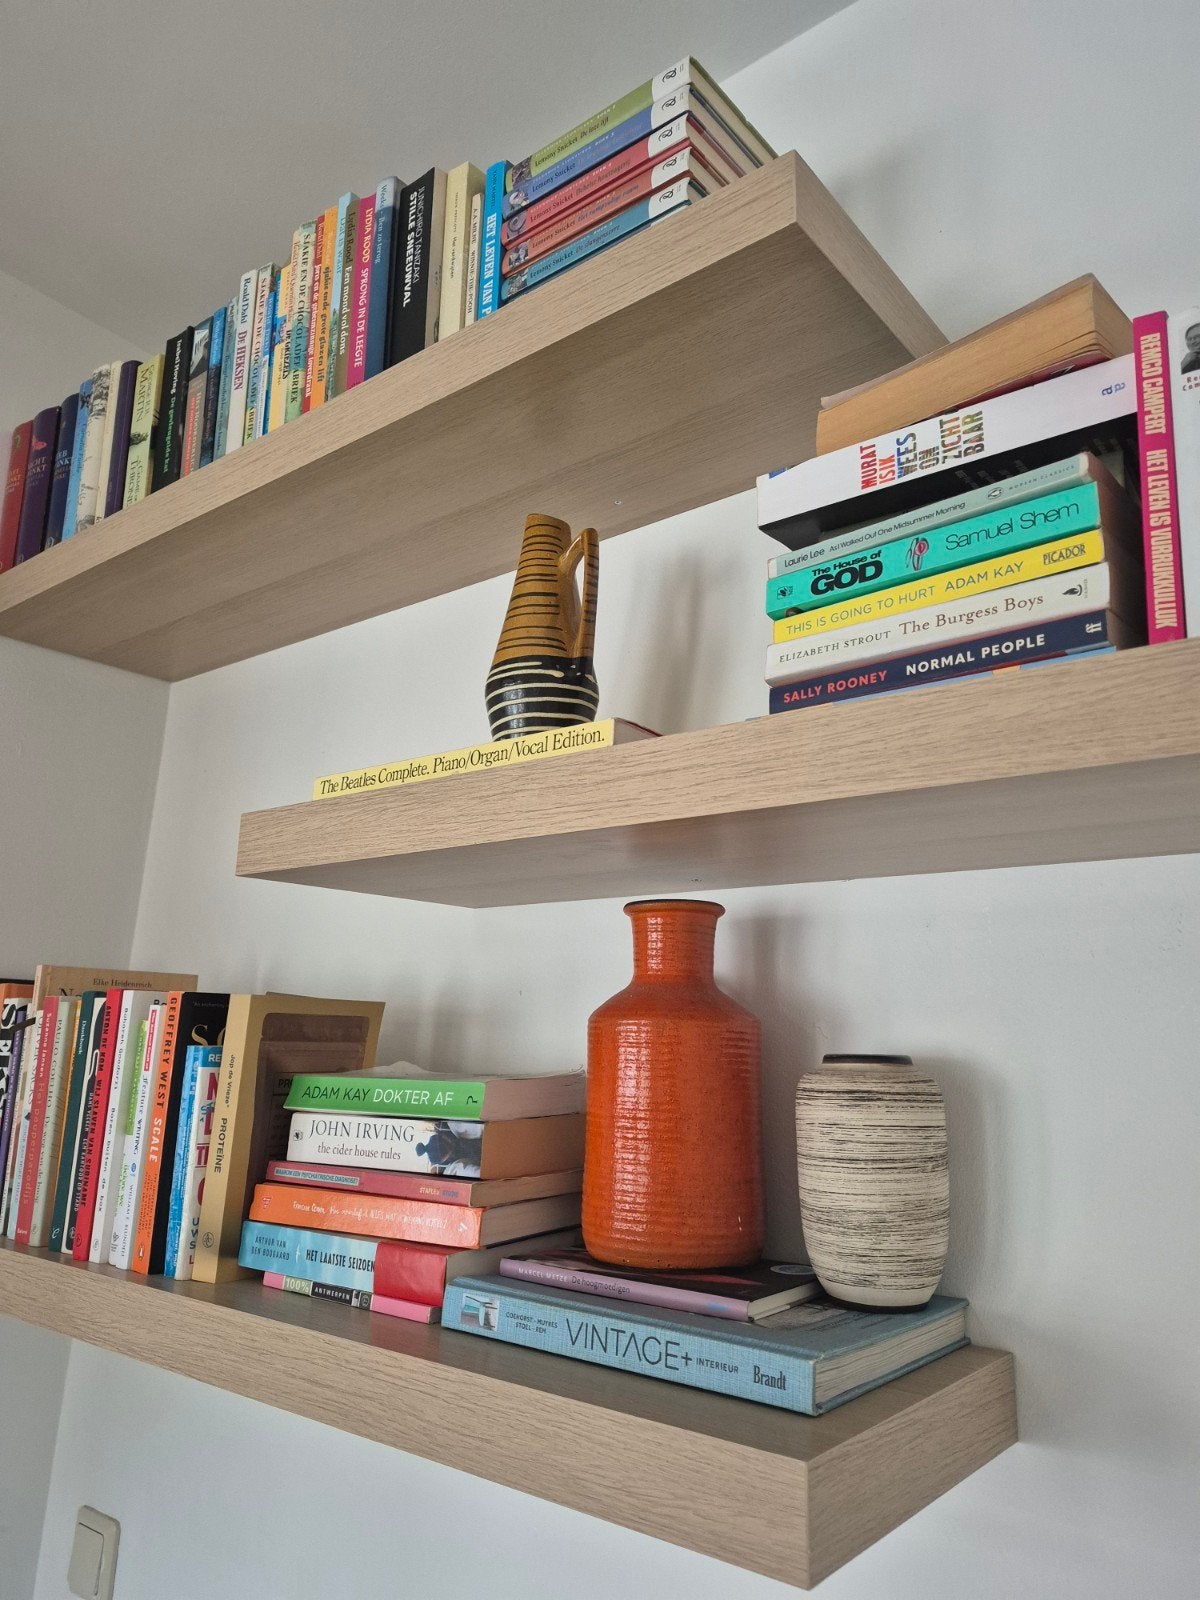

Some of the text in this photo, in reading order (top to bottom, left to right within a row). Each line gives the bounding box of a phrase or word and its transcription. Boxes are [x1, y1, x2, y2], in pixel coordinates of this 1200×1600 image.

[534, 152, 556, 168] Lemony
[557, 135, 577, 152] Snicket
[532, 163, 576, 192] Lemony Snicket
[486, 212, 496, 238] HET
[530, 194, 573, 223] Lemony Snicket
[376, 232, 382, 242] zo
[412, 185, 425, 284] JUNICHIRO TANIZAKI
[554, 221, 575, 235] Snicket
[374, 242, 382, 263] terug
[402, 191, 417, 308] STILLE SNEEUWVAL
[483, 238, 495, 280] LEVEN
[530, 250, 573, 280] Lemony Snicket
[311, 281, 319, 302] en de
[338, 211, 356, 355] Lydia Rood Een mond vol dons
[354, 207, 373, 368] LYDIA ROOD SPRONG IN DE LEEGTE
[482, 279, 493, 305] VAN
[233, 277, 251, 390] Roald Dahl HEKSEN
[290, 232, 311, 404] SJAKIE EN DE CHOCOLADEFABRIEK
[245, 277, 266, 440] SJAKIE EN DE CHOCOLADEFABRIEK
[282, 341, 290, 379] GRIEZELS
[316, 312, 327, 382] grote glazen lift
[135, 368, 148, 422] MARTIN
[169, 364, 179, 406] Hoving De
[939, 416, 963, 464] ZICHT
[961, 410, 985, 457] BAAR
[860, 443, 878, 490] MURAT
[878, 454, 896, 485] ISIK
[896, 432, 917, 479] WEES
[1140, 332, 1177, 630] REMCO CAMPERT HET LEVEN IS VURRUKKULLUK
[783, 500, 965, 568] Laurie Lee As Walked Out One Midsummer Morning
[944, 499, 1079, 551] Samuel Shem
[811, 549, 882, 577] The House of
[1043, 542, 1086, 565] PICADOR
[810, 558, 883, 596] GOD
[786, 560, 1025, 635] THIS IS GOING TO HURT ADAM KAY
[898, 591, 1044, 636] The Burgess Boys
[778, 630, 891, 663] ELIZABETH STROUT
[905, 633, 1045, 676] NORMAL PEOPLE
[783, 670, 887, 703] SALLY ROONEY
[319, 726, 605, 795] The Beatles Complete. Piano/Organ/Vocal Edition.
[93, 977, 152, 990] Elke Heidenreich
[102, 1004, 111, 1034] ANTON
[77, 1020, 86, 1054] Dankboek
[100, 1037, 107, 1049] DE
[46, 1019, 62, 1107] PAULO COELHO
[97, 1050, 105, 1072] KOM
[227, 1054, 236, 1079] Jop de
[138, 1073, 148, 1114] Feature
[149, 997, 177, 1162] GEOFFREY WEST SCALE
[301, 1085, 454, 1105] ADAM KAY DOKTER AF
[21, 1049, 47, 1206] Jansen Het pauperparadijs
[89, 1098, 99, 1133] SLAVEN
[308, 1119, 414, 1142] JOHN IRVING
[86, 1136, 94, 1155] VAN
[133, 1118, 143, 1154] WRITING
[213, 1117, 228, 1173] PROTEÏNE
[317, 1141, 400, 1160] the cider house rules
[103, 1140, 111, 1169] buiten
[80, 1157, 92, 1207] SURINAME
[101, 1177, 106, 1190] de
[275, 1239, 286, 1247] VAN
[306, 1248, 375, 1272] HET LAATSTE SEIZOEN
[518, 1267, 567, 1282] MARCEL METZE
[286, 1277, 309, 1293] 100%
[314, 1286, 350, 1299] ANTWERPEN
[571, 1275, 630, 1296] De hoogmoedigen
[696, 1357, 738, 1374] INTERIEUR
[753, 1363, 787, 1391] Brandt
